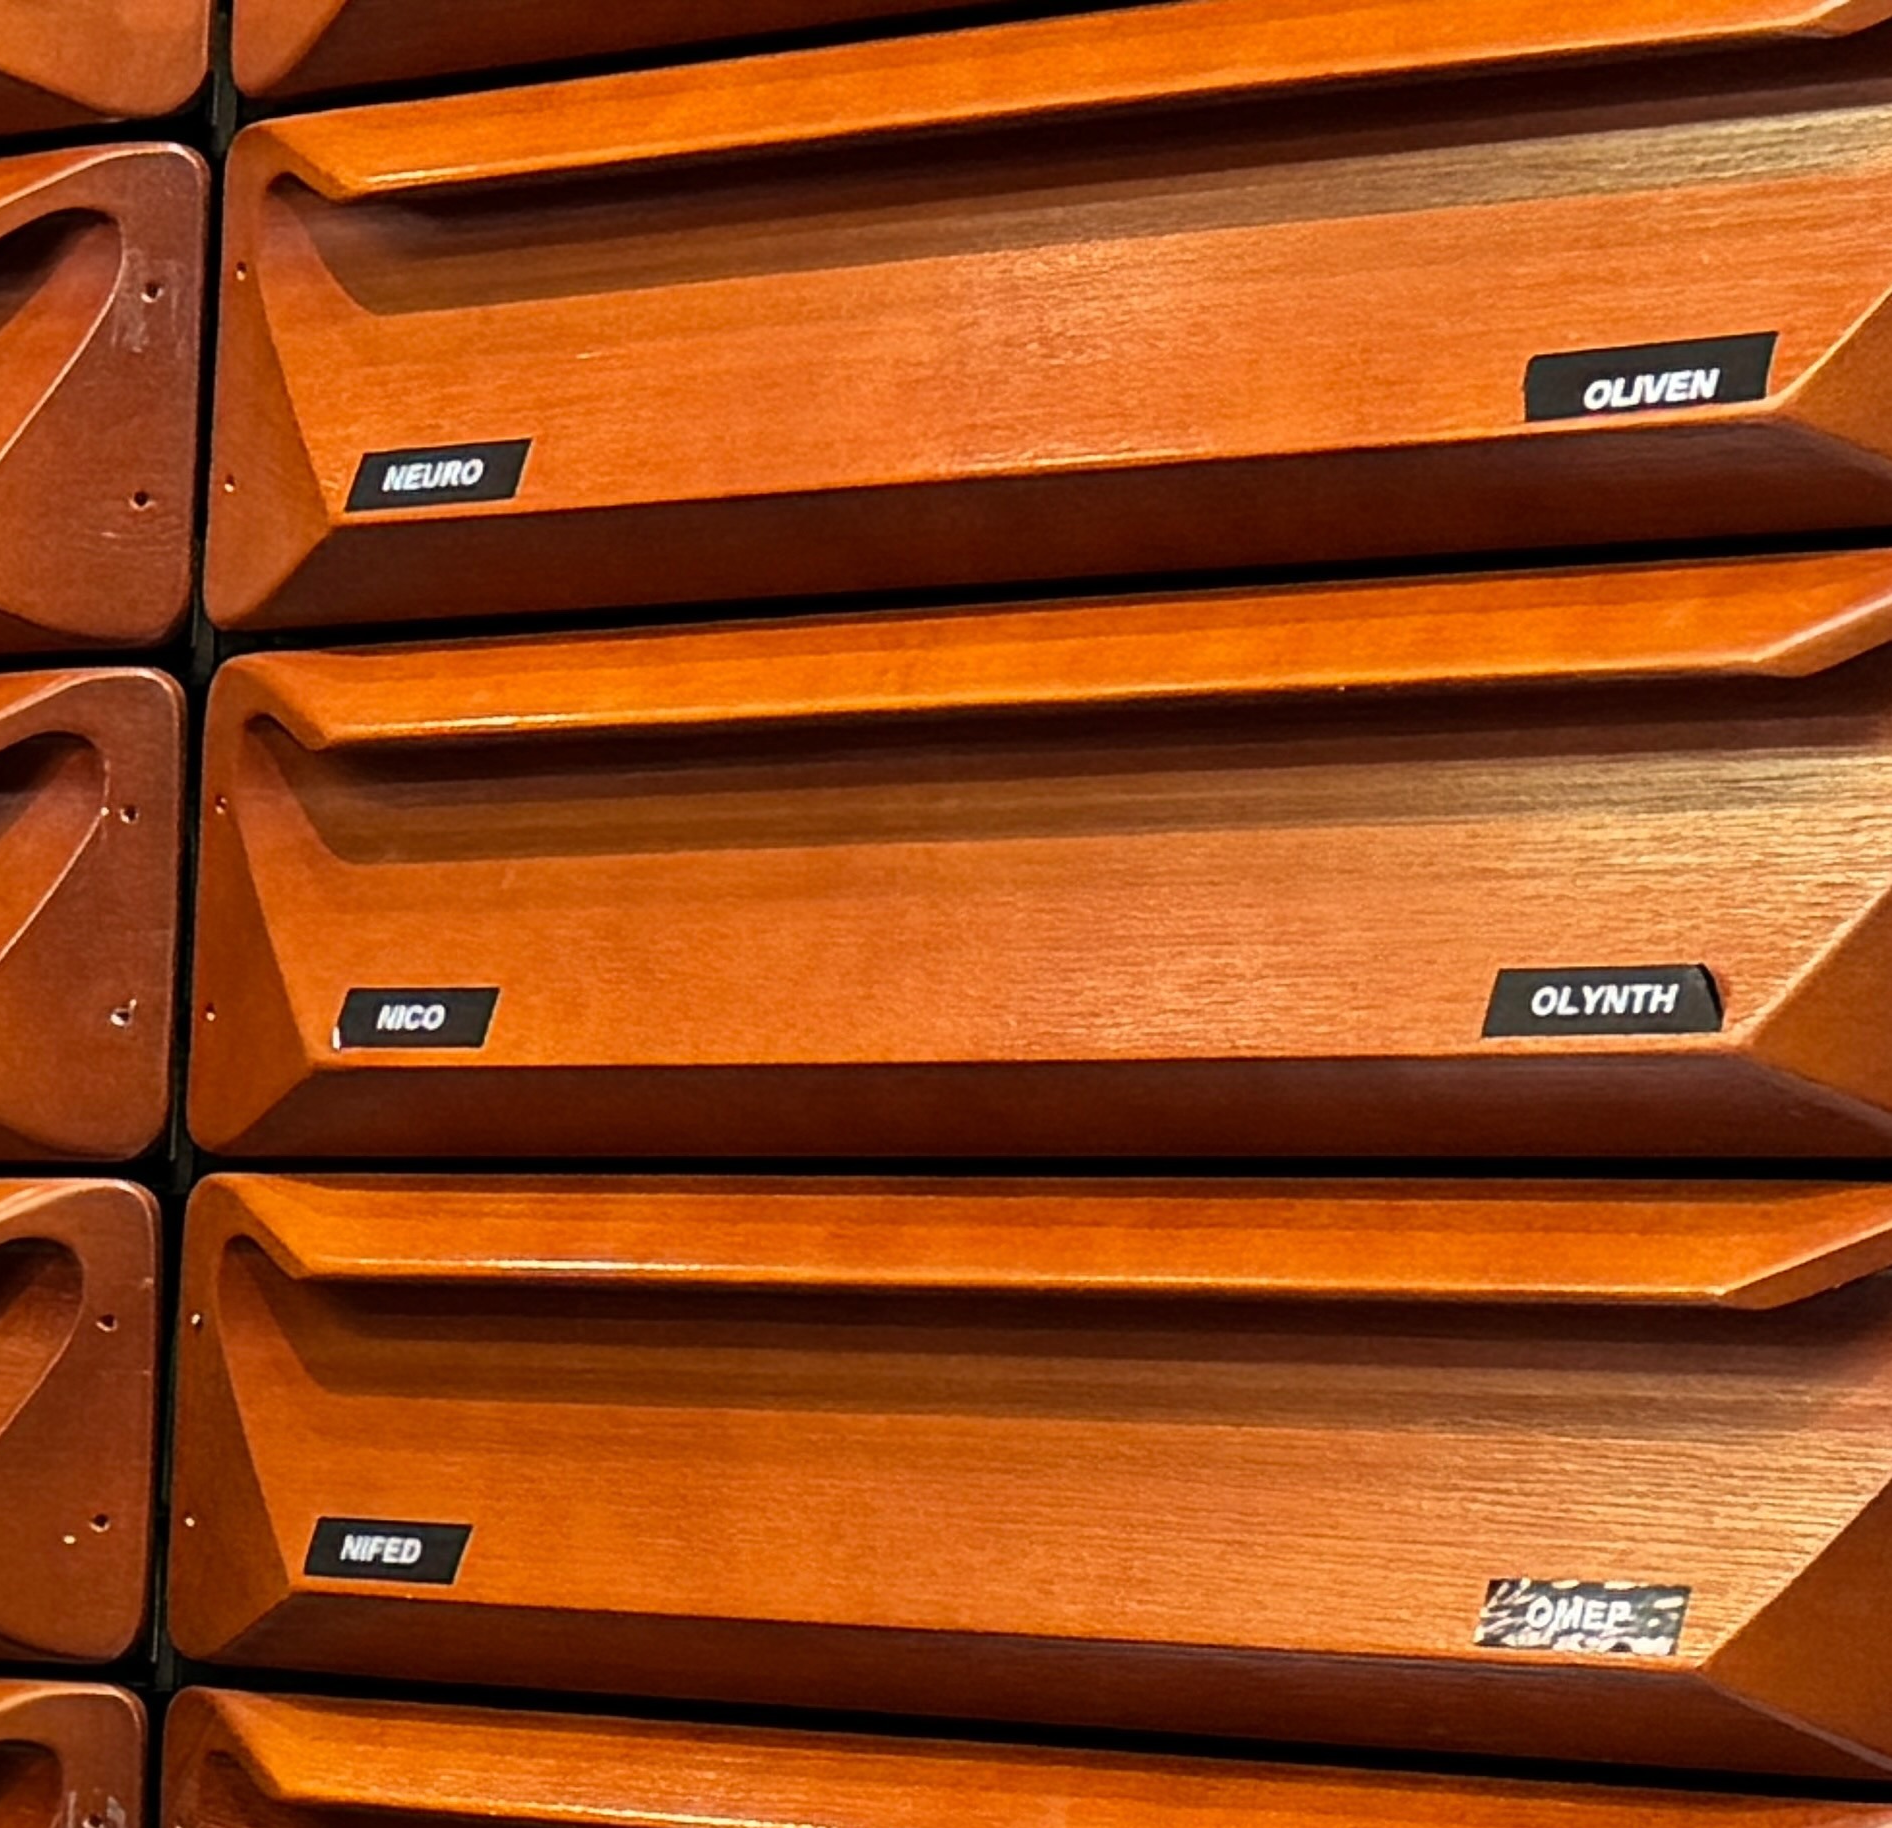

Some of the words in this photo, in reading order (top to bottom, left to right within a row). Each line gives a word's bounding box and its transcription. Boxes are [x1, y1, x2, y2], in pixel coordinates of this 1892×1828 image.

[1582, 367, 1721, 411] OLIVEN
[381, 458, 485, 493] NEURO
[1530, 983, 1680, 1017] OLYNTH
[375, 1004, 446, 1031] NICO
[339, 1534, 422, 1564] NIFED
[1525, 1594, 1633, 1632] OMEP
